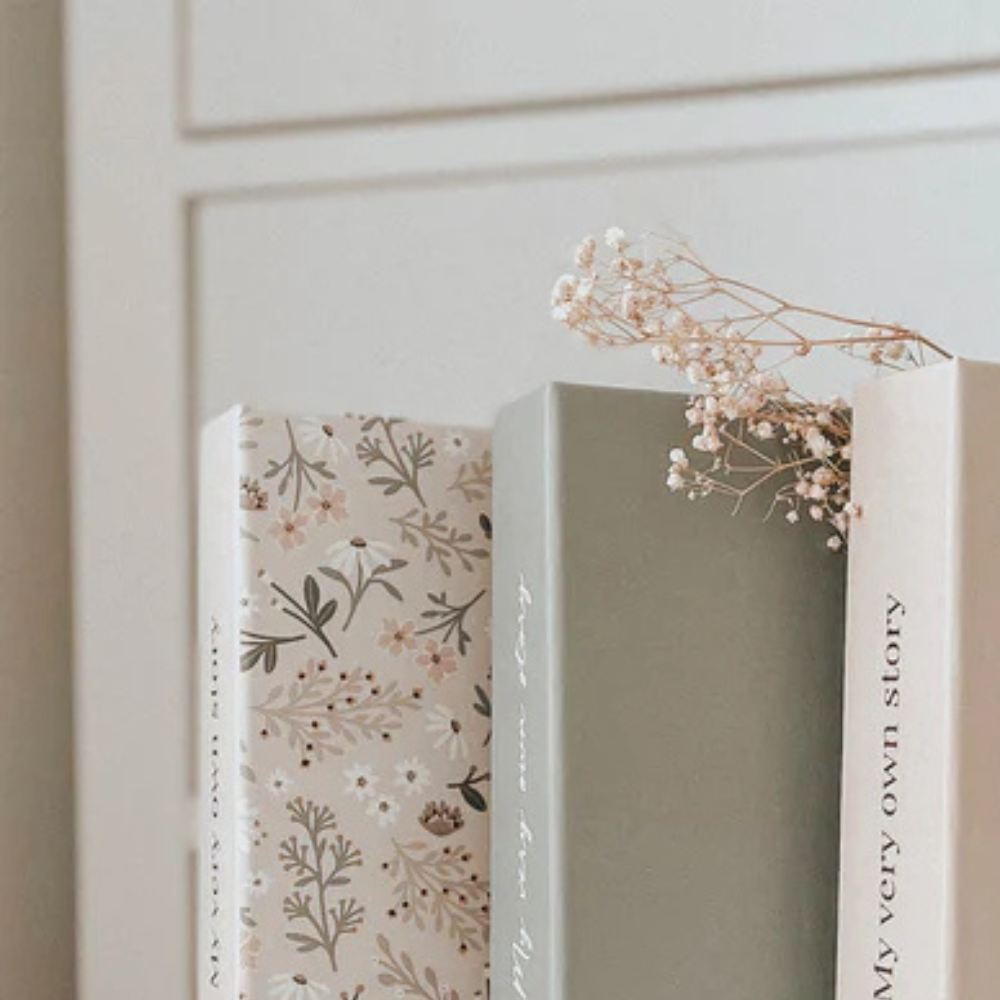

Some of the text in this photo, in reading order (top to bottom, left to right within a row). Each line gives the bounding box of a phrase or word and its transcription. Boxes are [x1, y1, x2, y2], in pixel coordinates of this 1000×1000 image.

[209, 615, 220, 718] story
[515, 573, 533, 689] story
[880, 593, 906, 708] story
[210, 734, 219, 819] own
[517, 702, 527, 793] own
[880, 724, 899, 818] own
[209, 830, 219, 918] very
[517, 808, 532, 900] very
[878, 830, 901, 926] very
[208, 929, 220, 989] My
[511, 916, 534, 1000] My
